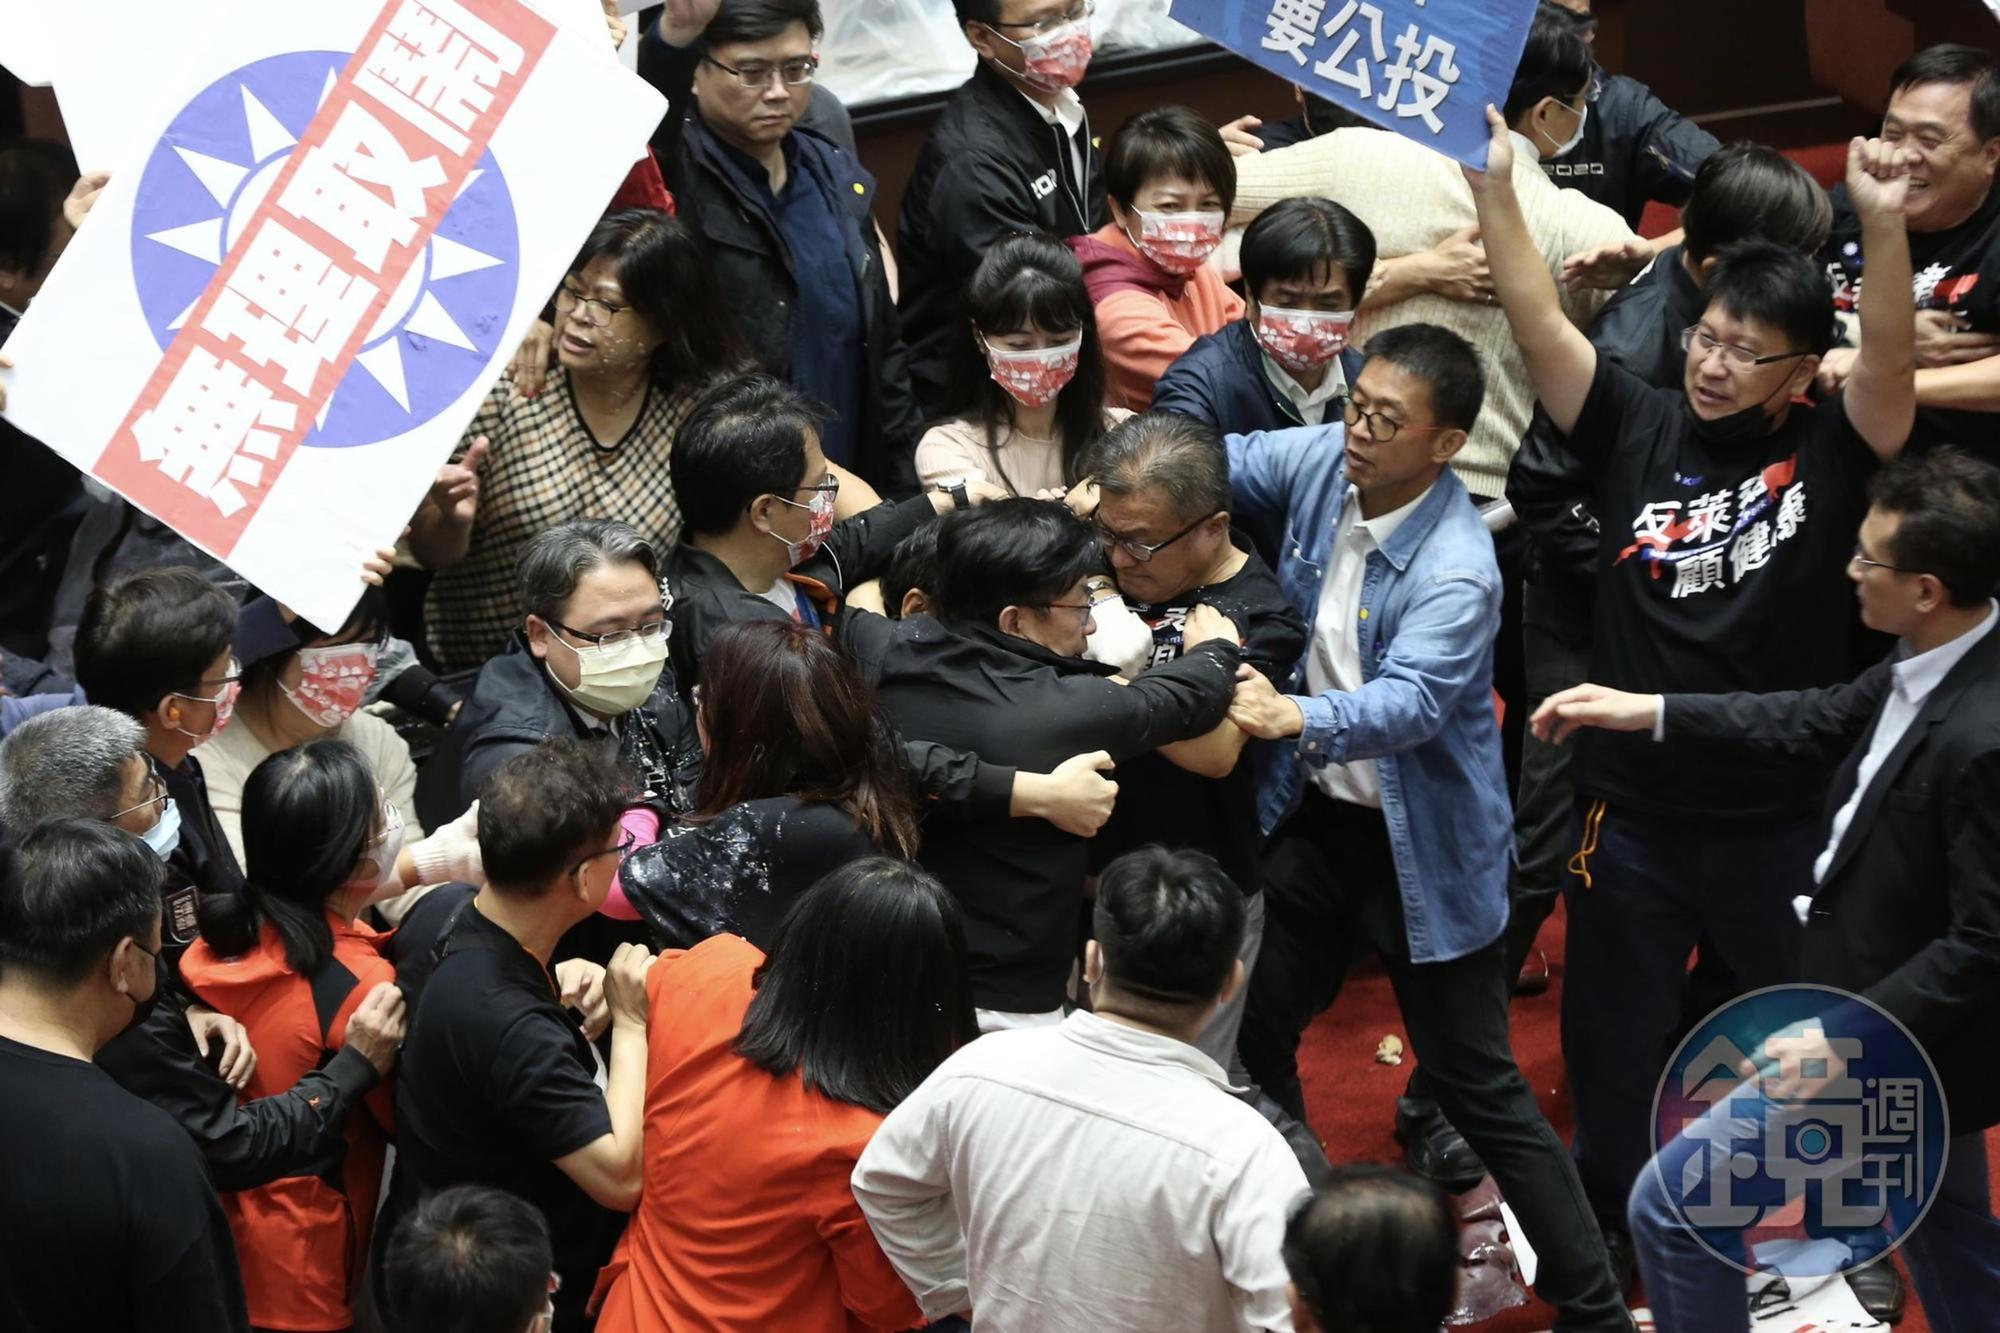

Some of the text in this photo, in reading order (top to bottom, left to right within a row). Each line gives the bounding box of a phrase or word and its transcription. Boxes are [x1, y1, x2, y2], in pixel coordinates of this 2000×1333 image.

[1261, 0, 1461, 134] 要公投
[130, 0, 526, 518] 無理取鬧
